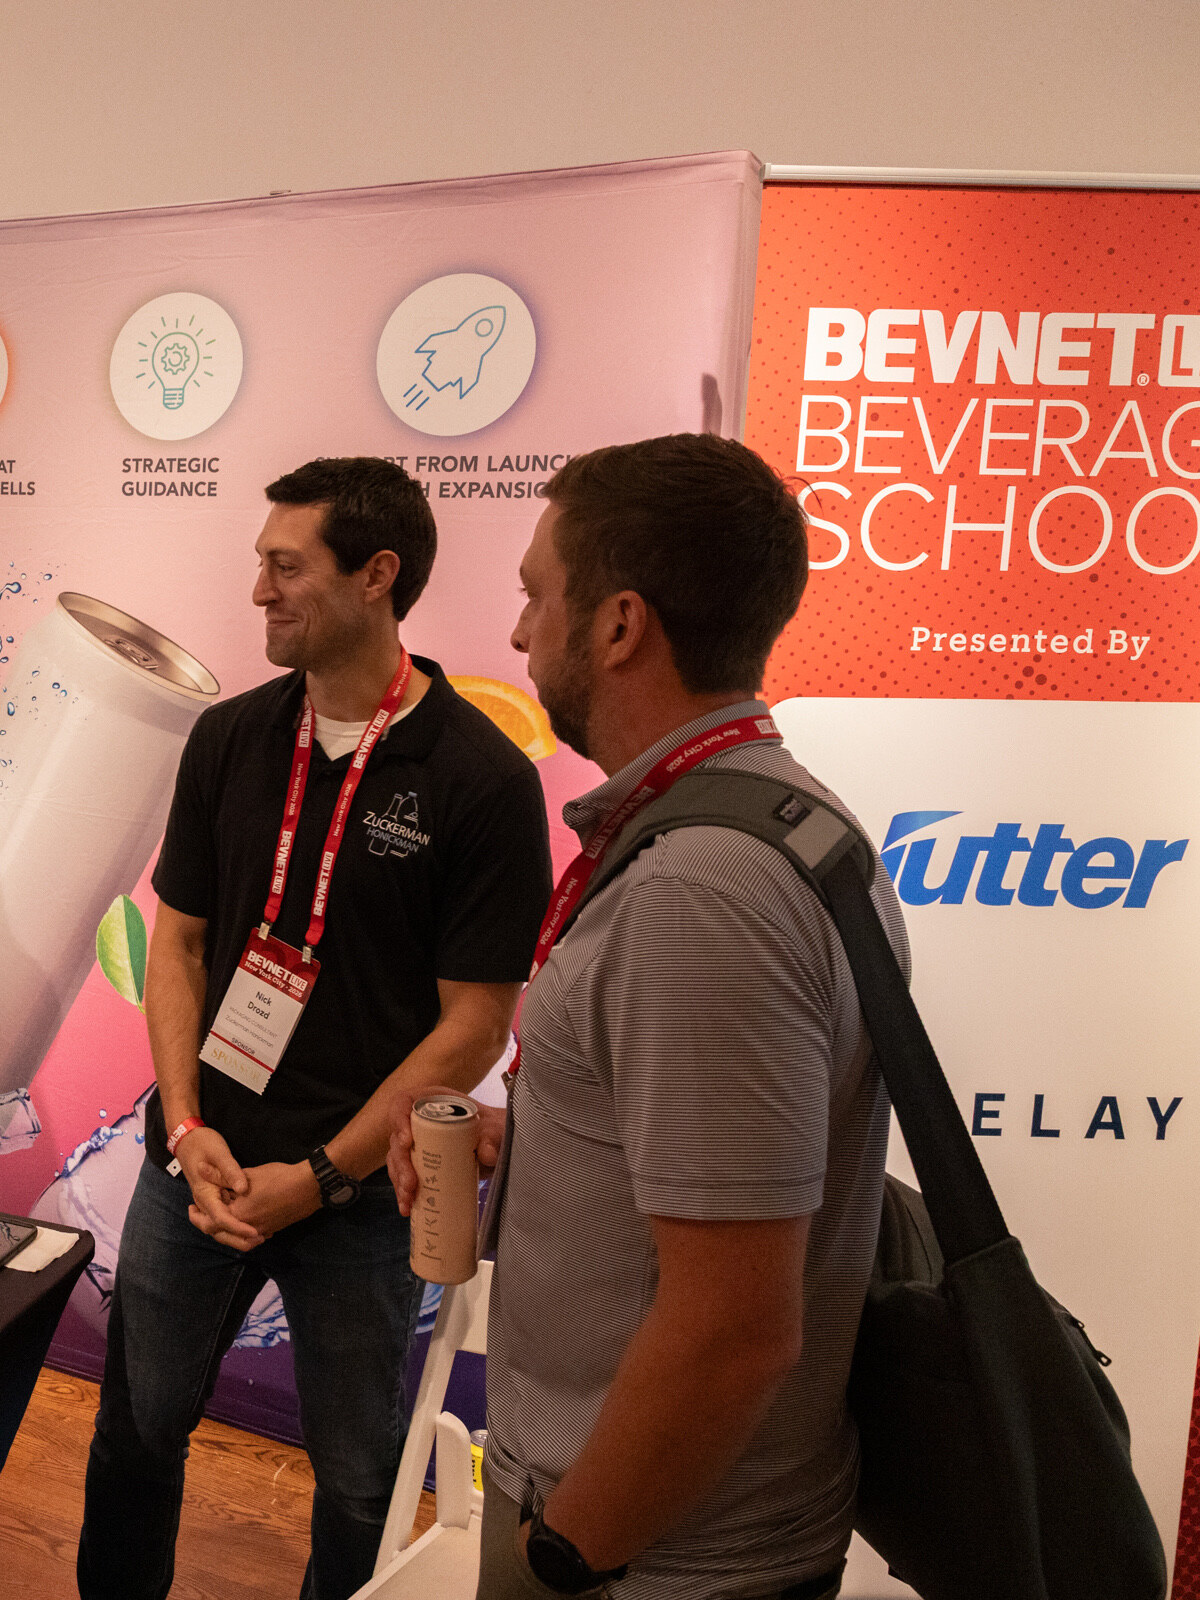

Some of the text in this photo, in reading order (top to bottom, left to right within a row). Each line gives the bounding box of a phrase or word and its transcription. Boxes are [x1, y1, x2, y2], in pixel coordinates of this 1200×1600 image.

[795, 394, 1200, 480] BEVERAG
[121, 457, 220, 474] STRATEGIC
[416, 456, 478, 473] FROM
[487, 454, 572, 473] LAUNC
[121, 481, 218, 498] GUIDANCE
[439, 482, 548, 499] EXPANSIO
[797, 481, 1200, 575] SCHOO
[910, 626, 1150, 660] Presented By
[352, 708, 389, 769] BEVNET LIVE
[702, 734, 724, 747] York
[723, 728, 741, 737] New
[684, 744, 703, 759] City
[363, 811, 430, 846] ZUCKERMAN
[366, 826, 420, 853] HONICKMAN
[272, 830, 293, 894] BEVNET LIVE
[313, 851, 334, 917] BEVNET LIVE
[565, 878, 578, 895] New
[557, 894, 569, 911] York
[550, 911, 560, 929] City
[247, 950, 291, 983] BEVNET
[255, 991, 272, 1006] Nick
[247, 1001, 271, 1019] Drozd
[231, 1037, 256, 1055] SPONSOR
[971, 1093, 1184, 1141] ELAY
